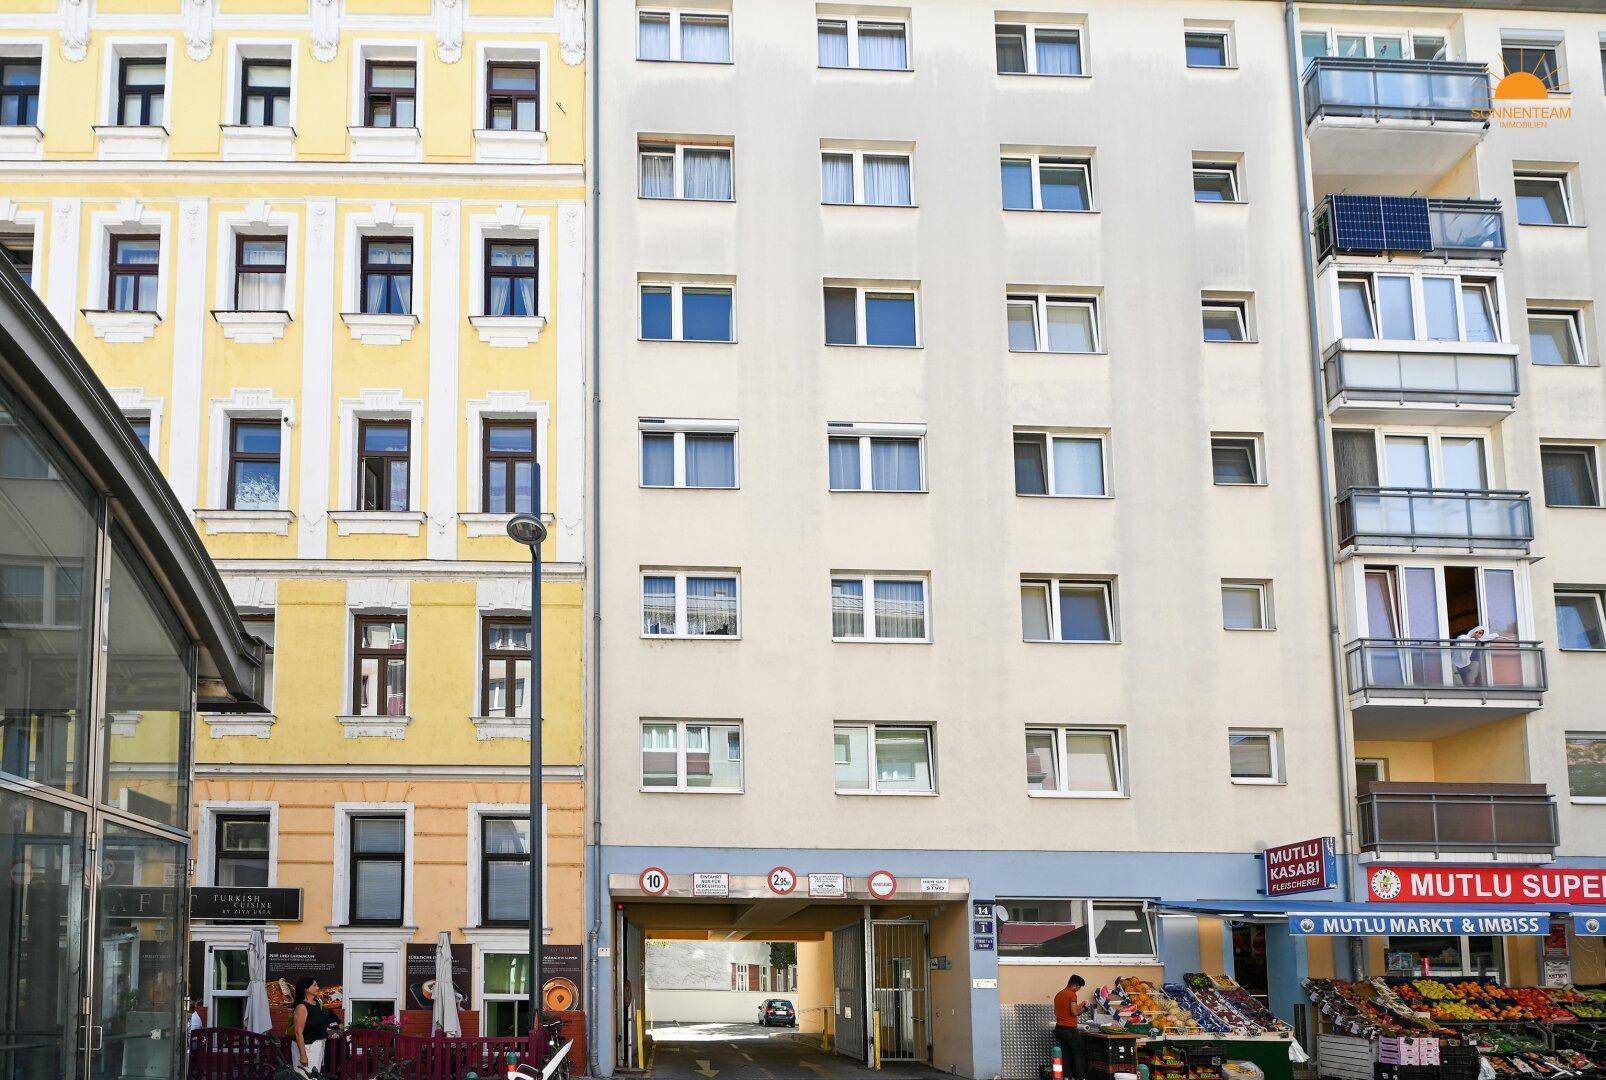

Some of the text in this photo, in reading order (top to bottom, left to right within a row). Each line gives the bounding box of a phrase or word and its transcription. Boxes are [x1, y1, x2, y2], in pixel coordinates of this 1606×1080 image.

[1269, 843, 1319, 865] MUTLU
[1270, 860, 1320, 880] KASABI
[647, 875, 661, 888] 10
[1271, 877, 1320, 892] FLEISCHEREI
[1410, 873, 1606, 898] MUTLU SUPE
[213, 894, 260, 902] TURKISH
[977, 906, 989, 916] 14
[980, 924, 986, 933] 1
[1323, 918, 1540, 933] MUTLU MARKT & IMBISS
